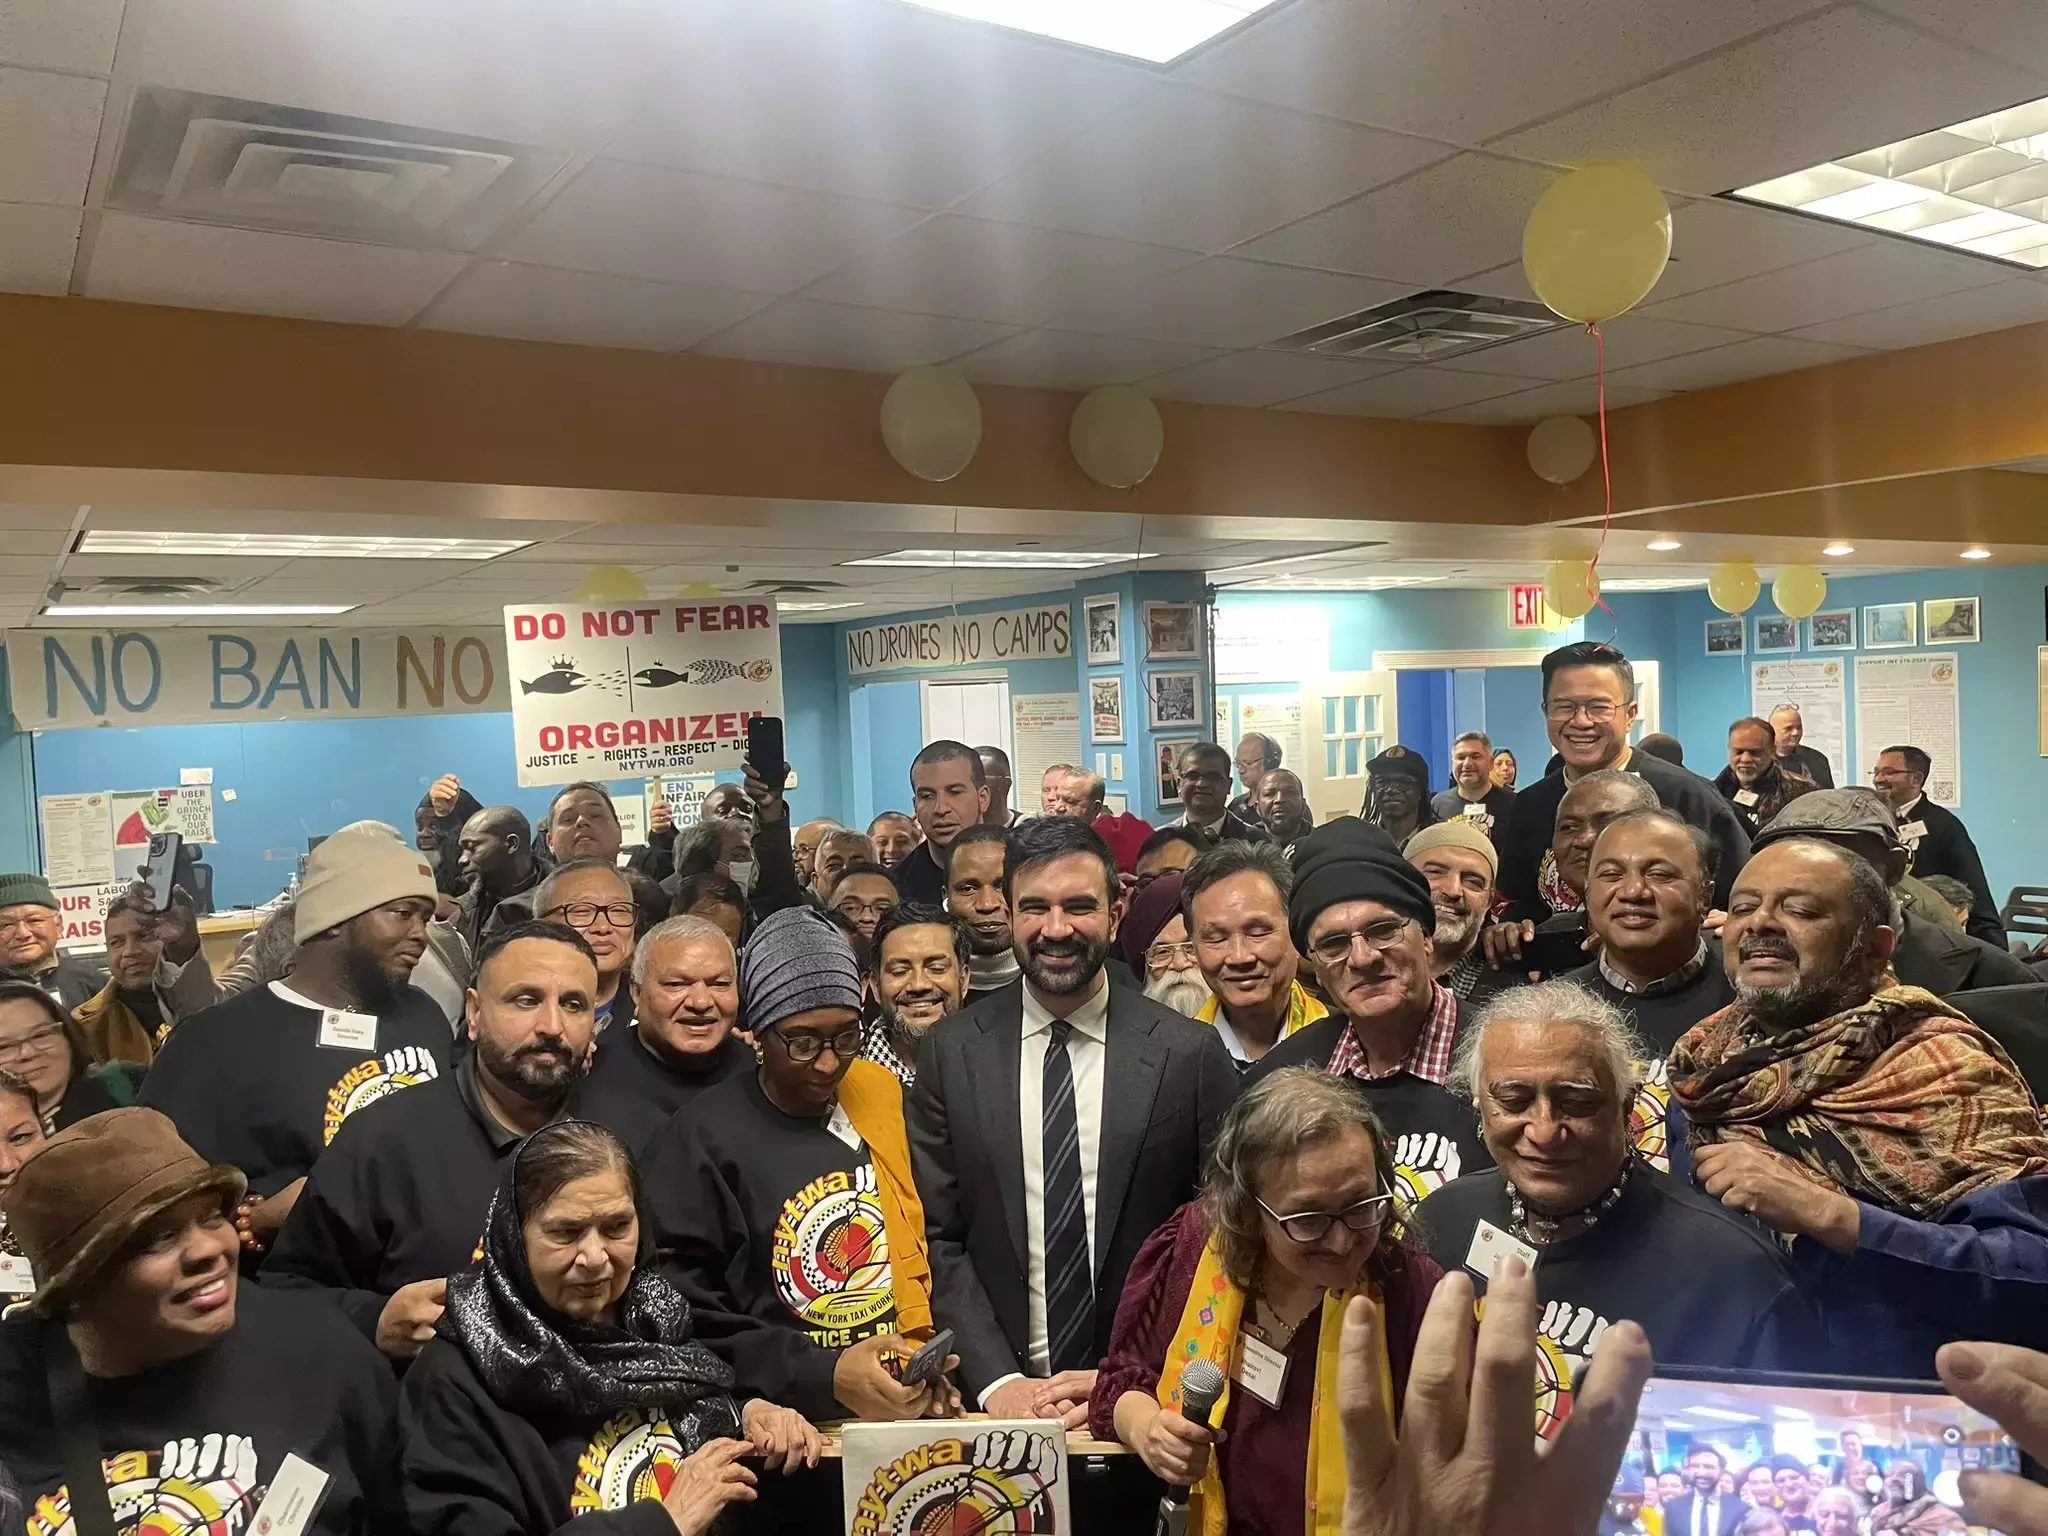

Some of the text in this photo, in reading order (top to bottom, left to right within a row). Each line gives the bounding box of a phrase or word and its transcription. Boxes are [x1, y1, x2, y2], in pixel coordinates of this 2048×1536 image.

[1515, 587, 1545, 625] EXIT
[514, 604, 771, 641] DO NOT FEAR
[848, 610, 1069, 670] NO DRONES NO CAMPS
[43, 632, 494, 719] NO BAN NO
[539, 711, 762, 752] ORGANIZE!
[526, 753, 578, 768] JUSTICE
[604, 747, 648, 762] RIGHTS
[664, 741, 717, 757] RESPECT
[619, 756, 694, 771] NYTWA.ORG
[181, 789, 206, 799] UBER
[667, 781, 694, 793] END
[177, 804, 211, 814] GRINCH
[186, 798, 203, 806] THE
[182, 813, 208, 822] STOLE
[187, 821, 206, 829] OUR
[185, 828, 211, 837] RAISE
[61, 919, 106, 940] AIS
[771, 1169, 850, 1273] nytwa
[806, 1308, 826, 1321] NEW
[828, 1313, 848, 1324] YORK
[850, 1307, 868, 1322] TAXI
[802, 1328, 852, 1348] TICE
